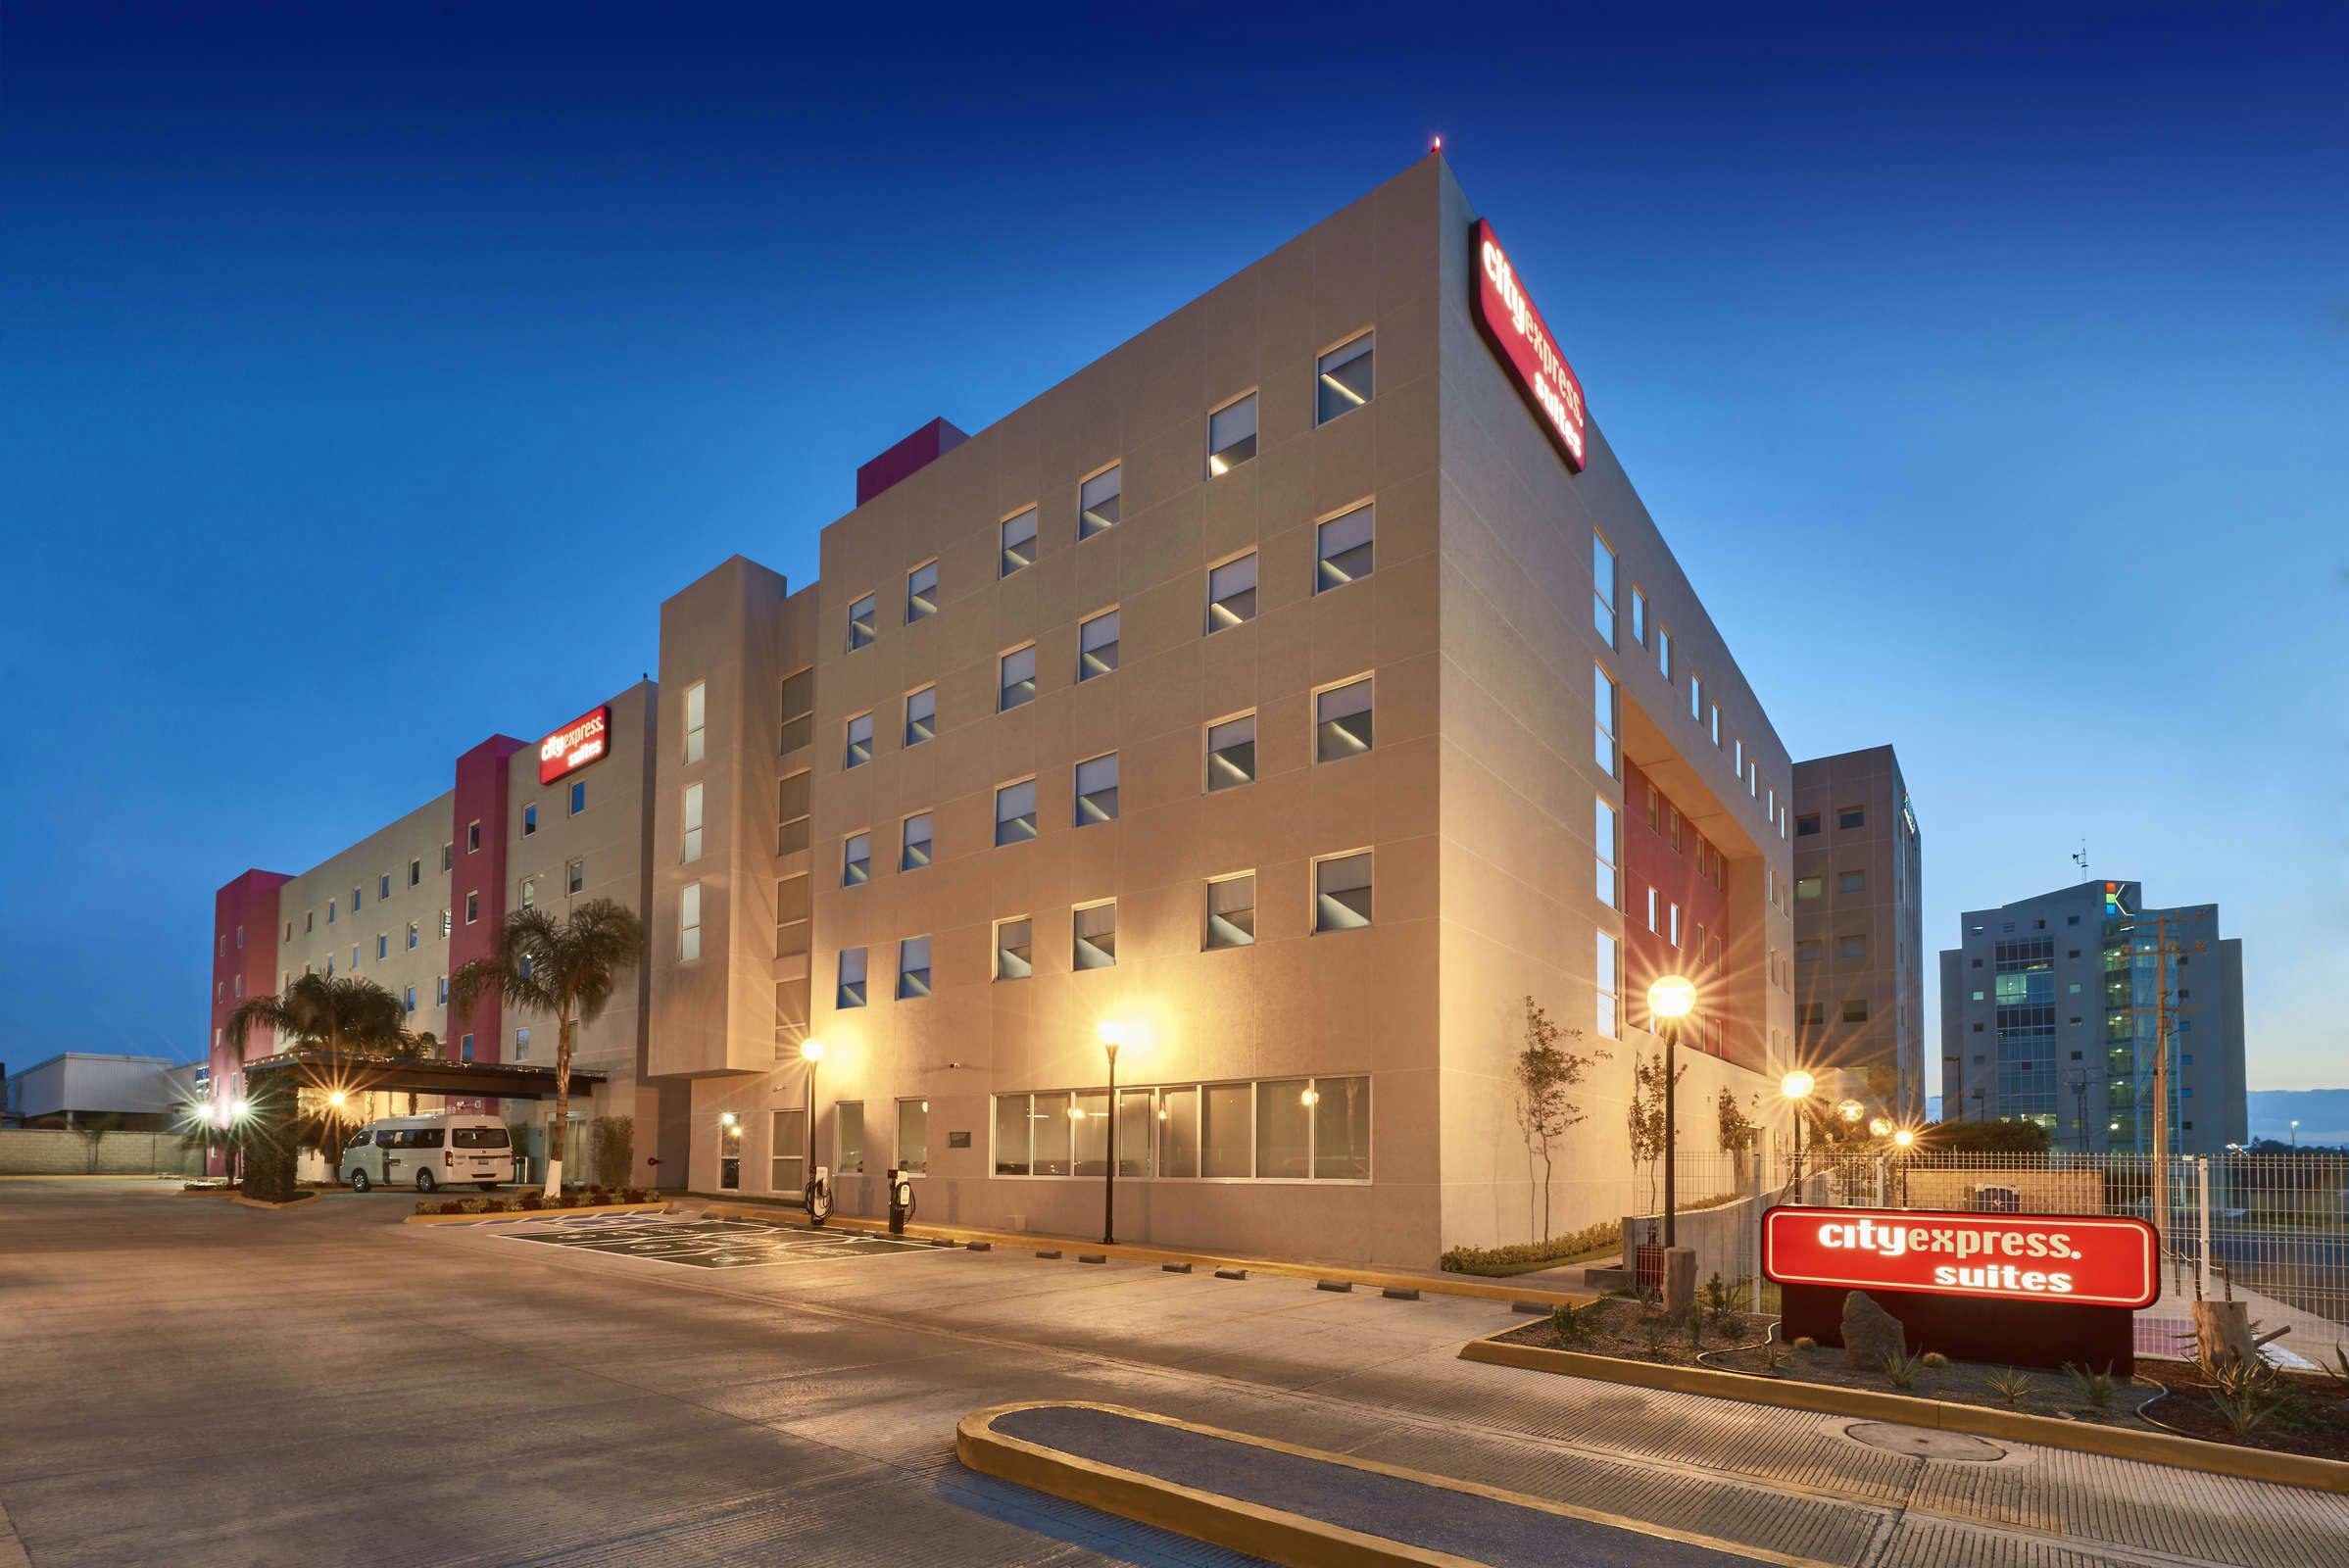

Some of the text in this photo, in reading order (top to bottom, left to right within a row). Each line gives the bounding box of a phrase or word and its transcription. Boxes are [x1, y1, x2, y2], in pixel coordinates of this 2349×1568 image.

[1534, 371, 1583, 459] suites
[567, 739, 602, 767] suites
[1934, 1264, 2073, 1294] suites
